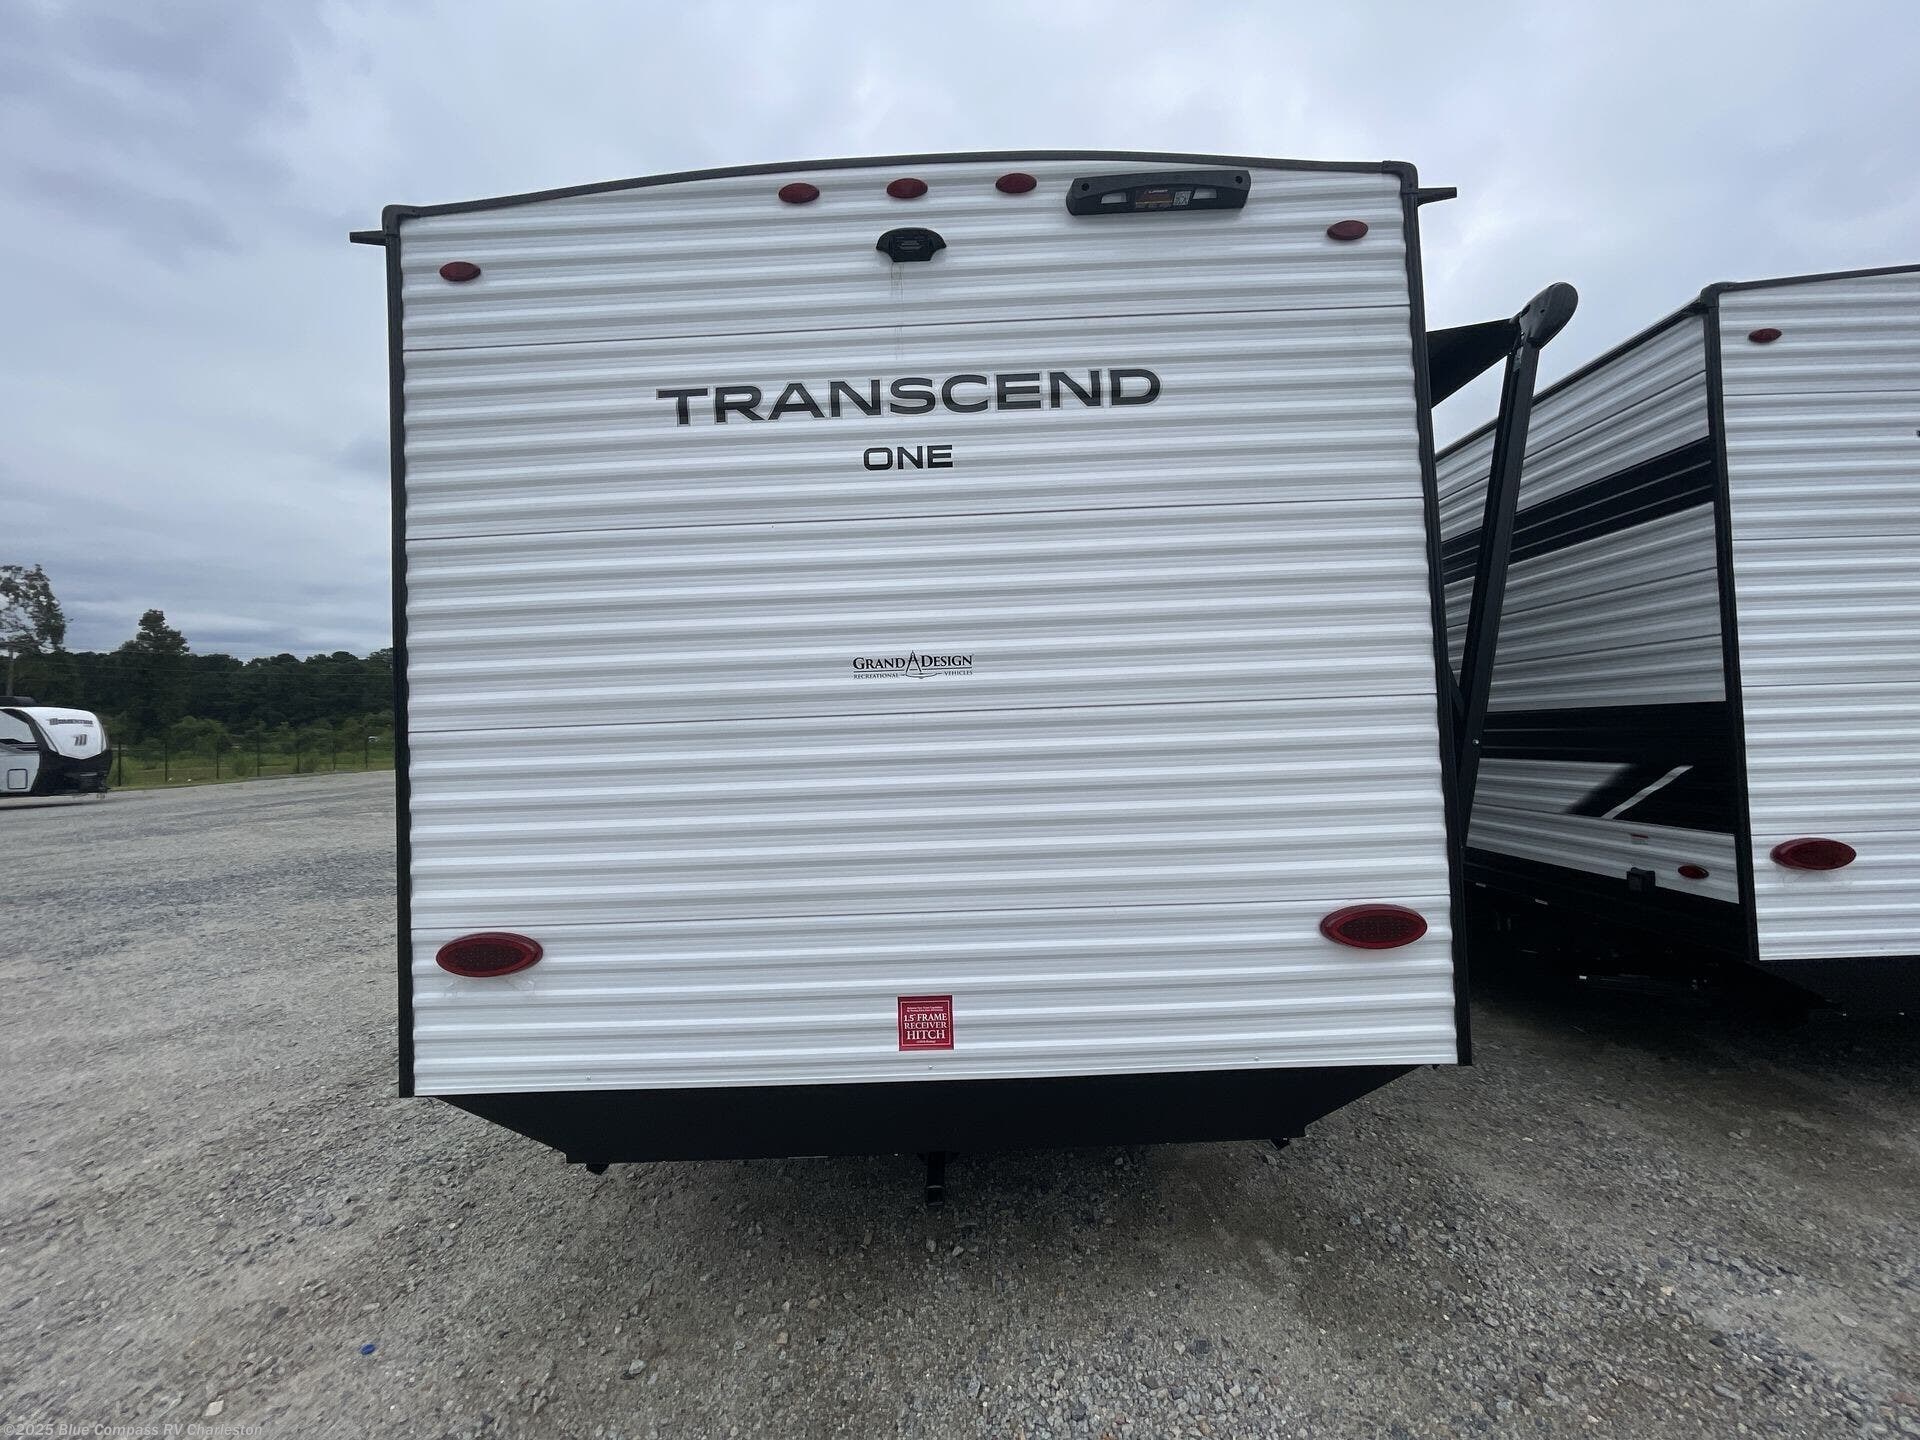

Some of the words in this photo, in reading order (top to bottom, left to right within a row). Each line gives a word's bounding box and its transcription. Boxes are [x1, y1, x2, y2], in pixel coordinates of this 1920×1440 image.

[656, 368, 1162, 426] TRANSCEND
[863, 444, 953, 471] ONE
[853, 657, 905, 669] GRAND
[921, 655, 972, 667] DESIGN
[917, 1013, 948, 1021] FRAME
[907, 1030, 945, 1039] HITCH
